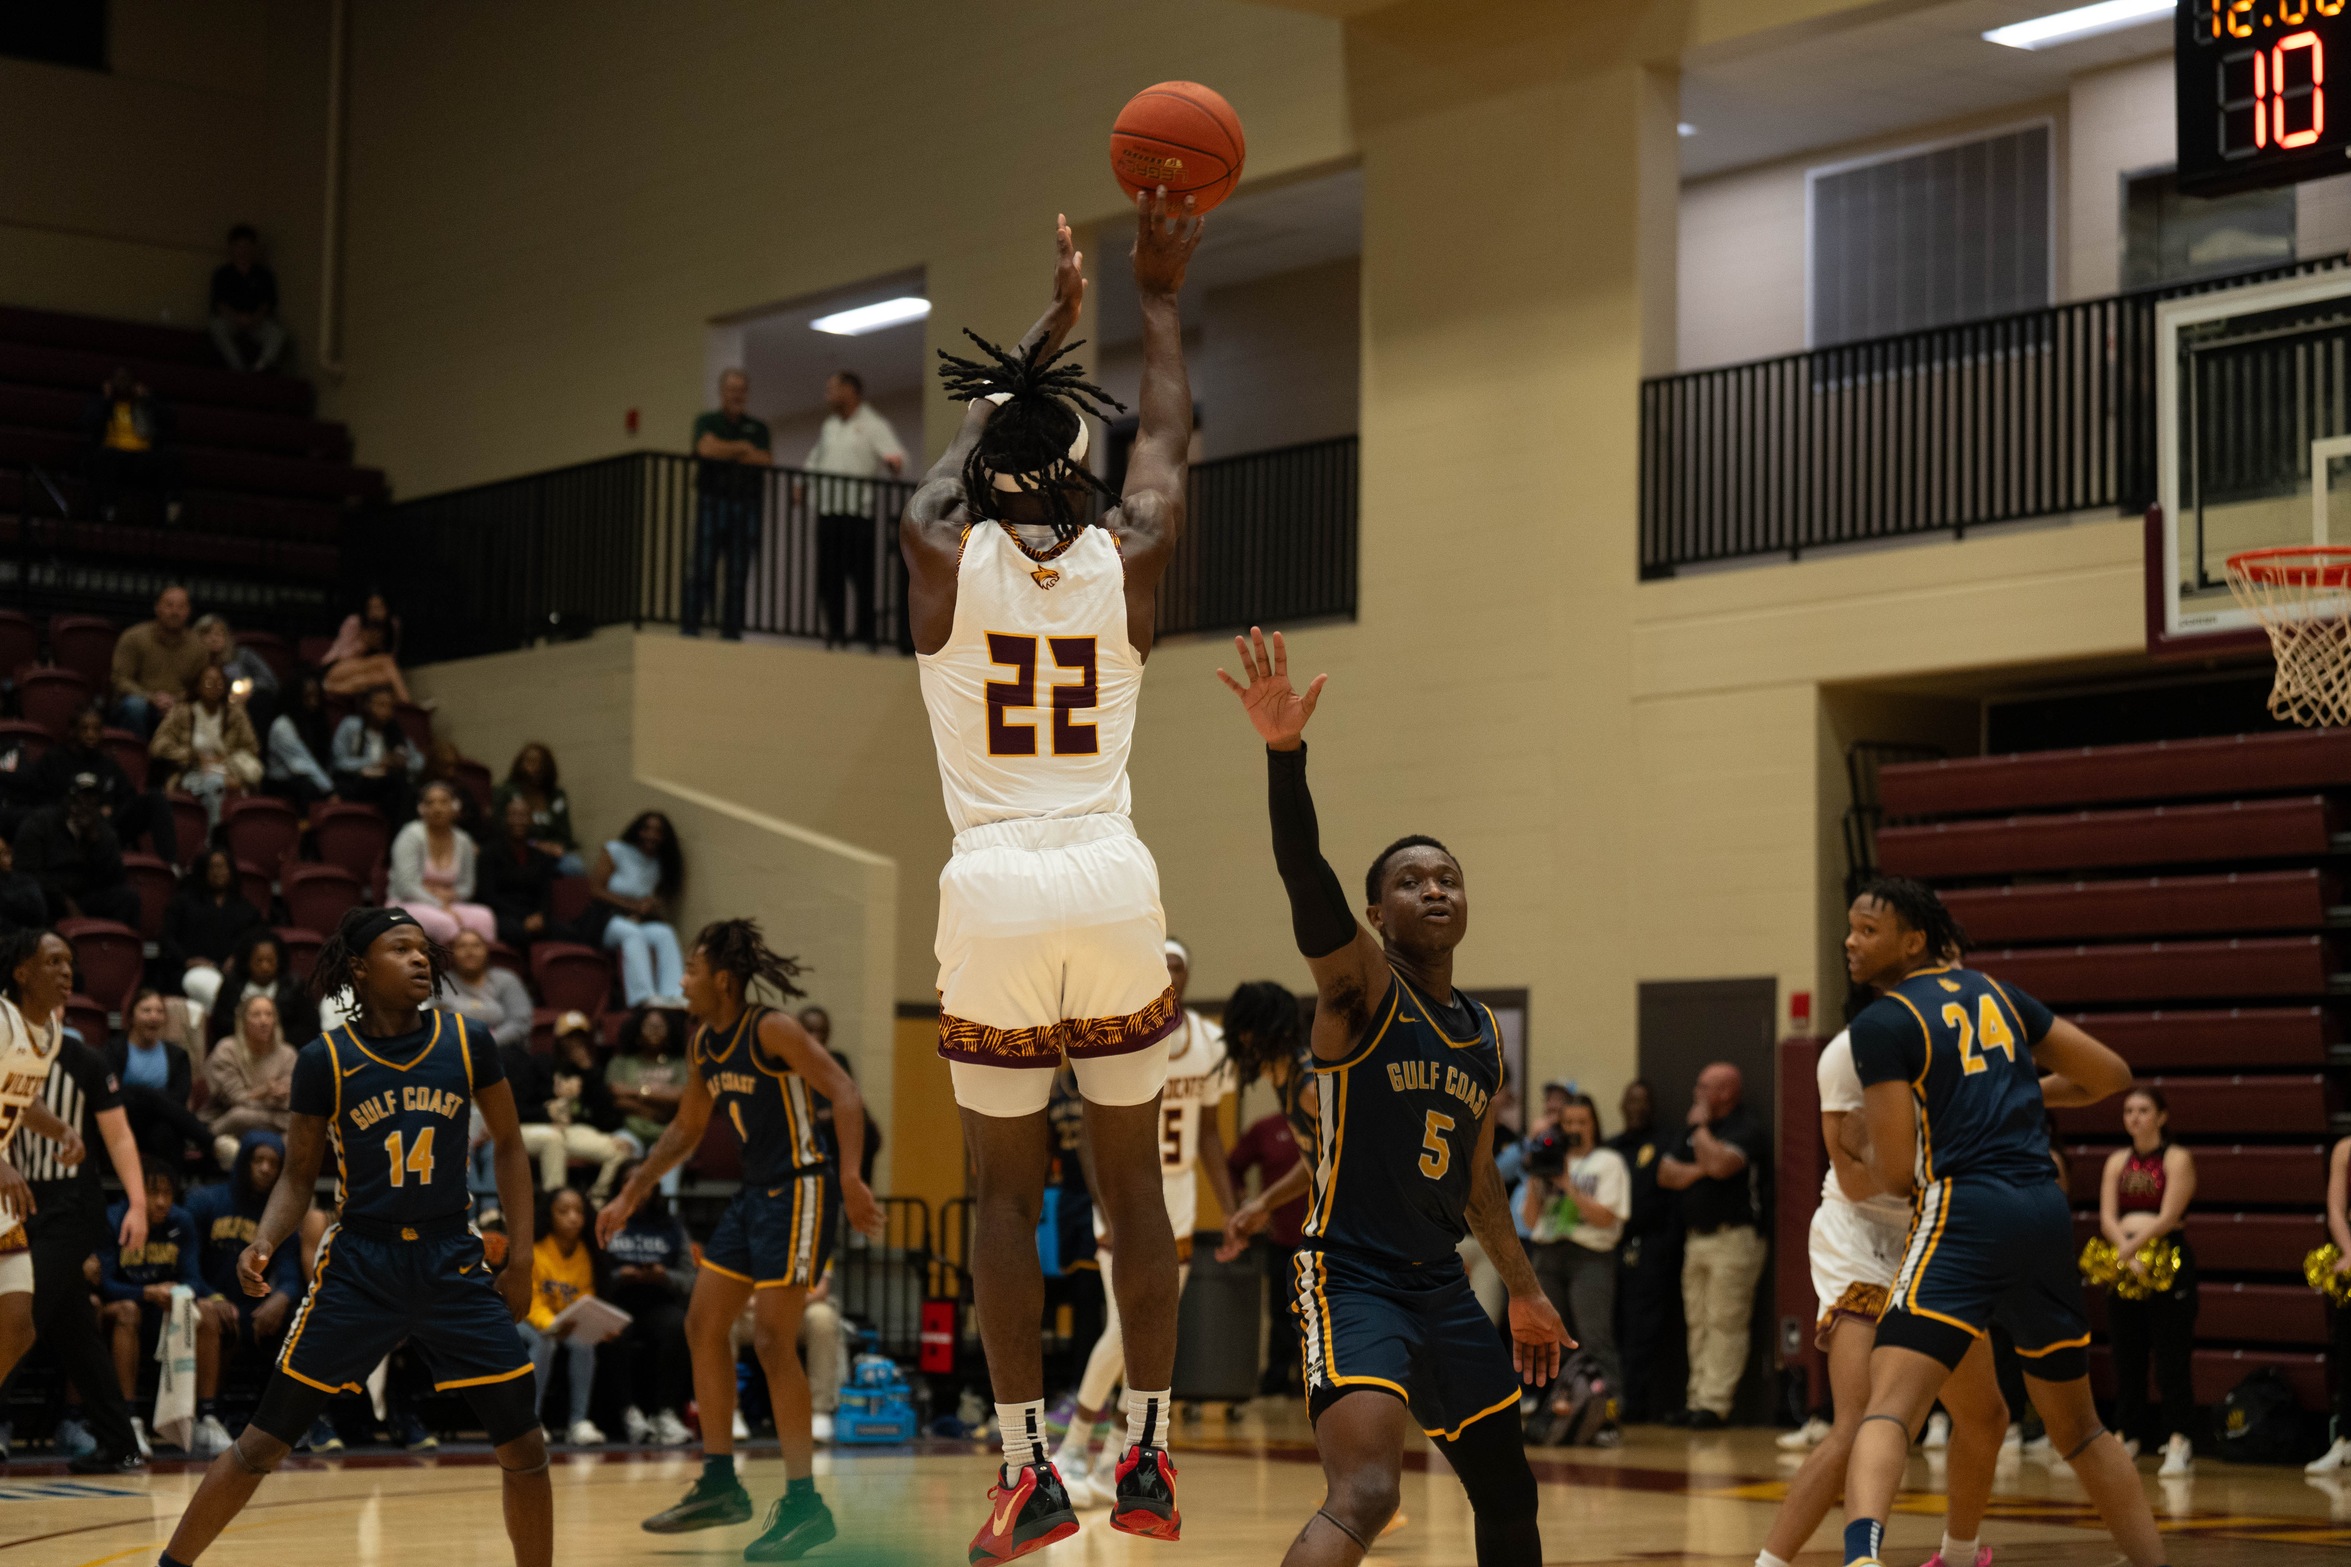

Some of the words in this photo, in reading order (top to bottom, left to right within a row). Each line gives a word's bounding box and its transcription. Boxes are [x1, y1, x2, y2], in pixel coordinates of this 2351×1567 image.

[2253, 30, 2325, 150] 10
[983, 630, 1101, 758] 22
[1941, 993, 2016, 1077] 24
[350, 1090, 397, 1131] GULF
[402, 1086, 464, 1119] COAST
[1386, 1060, 1440, 1092] GULF
[384, 1126, 435, 1188] 14
[1418, 1108, 1456, 1181] 5
